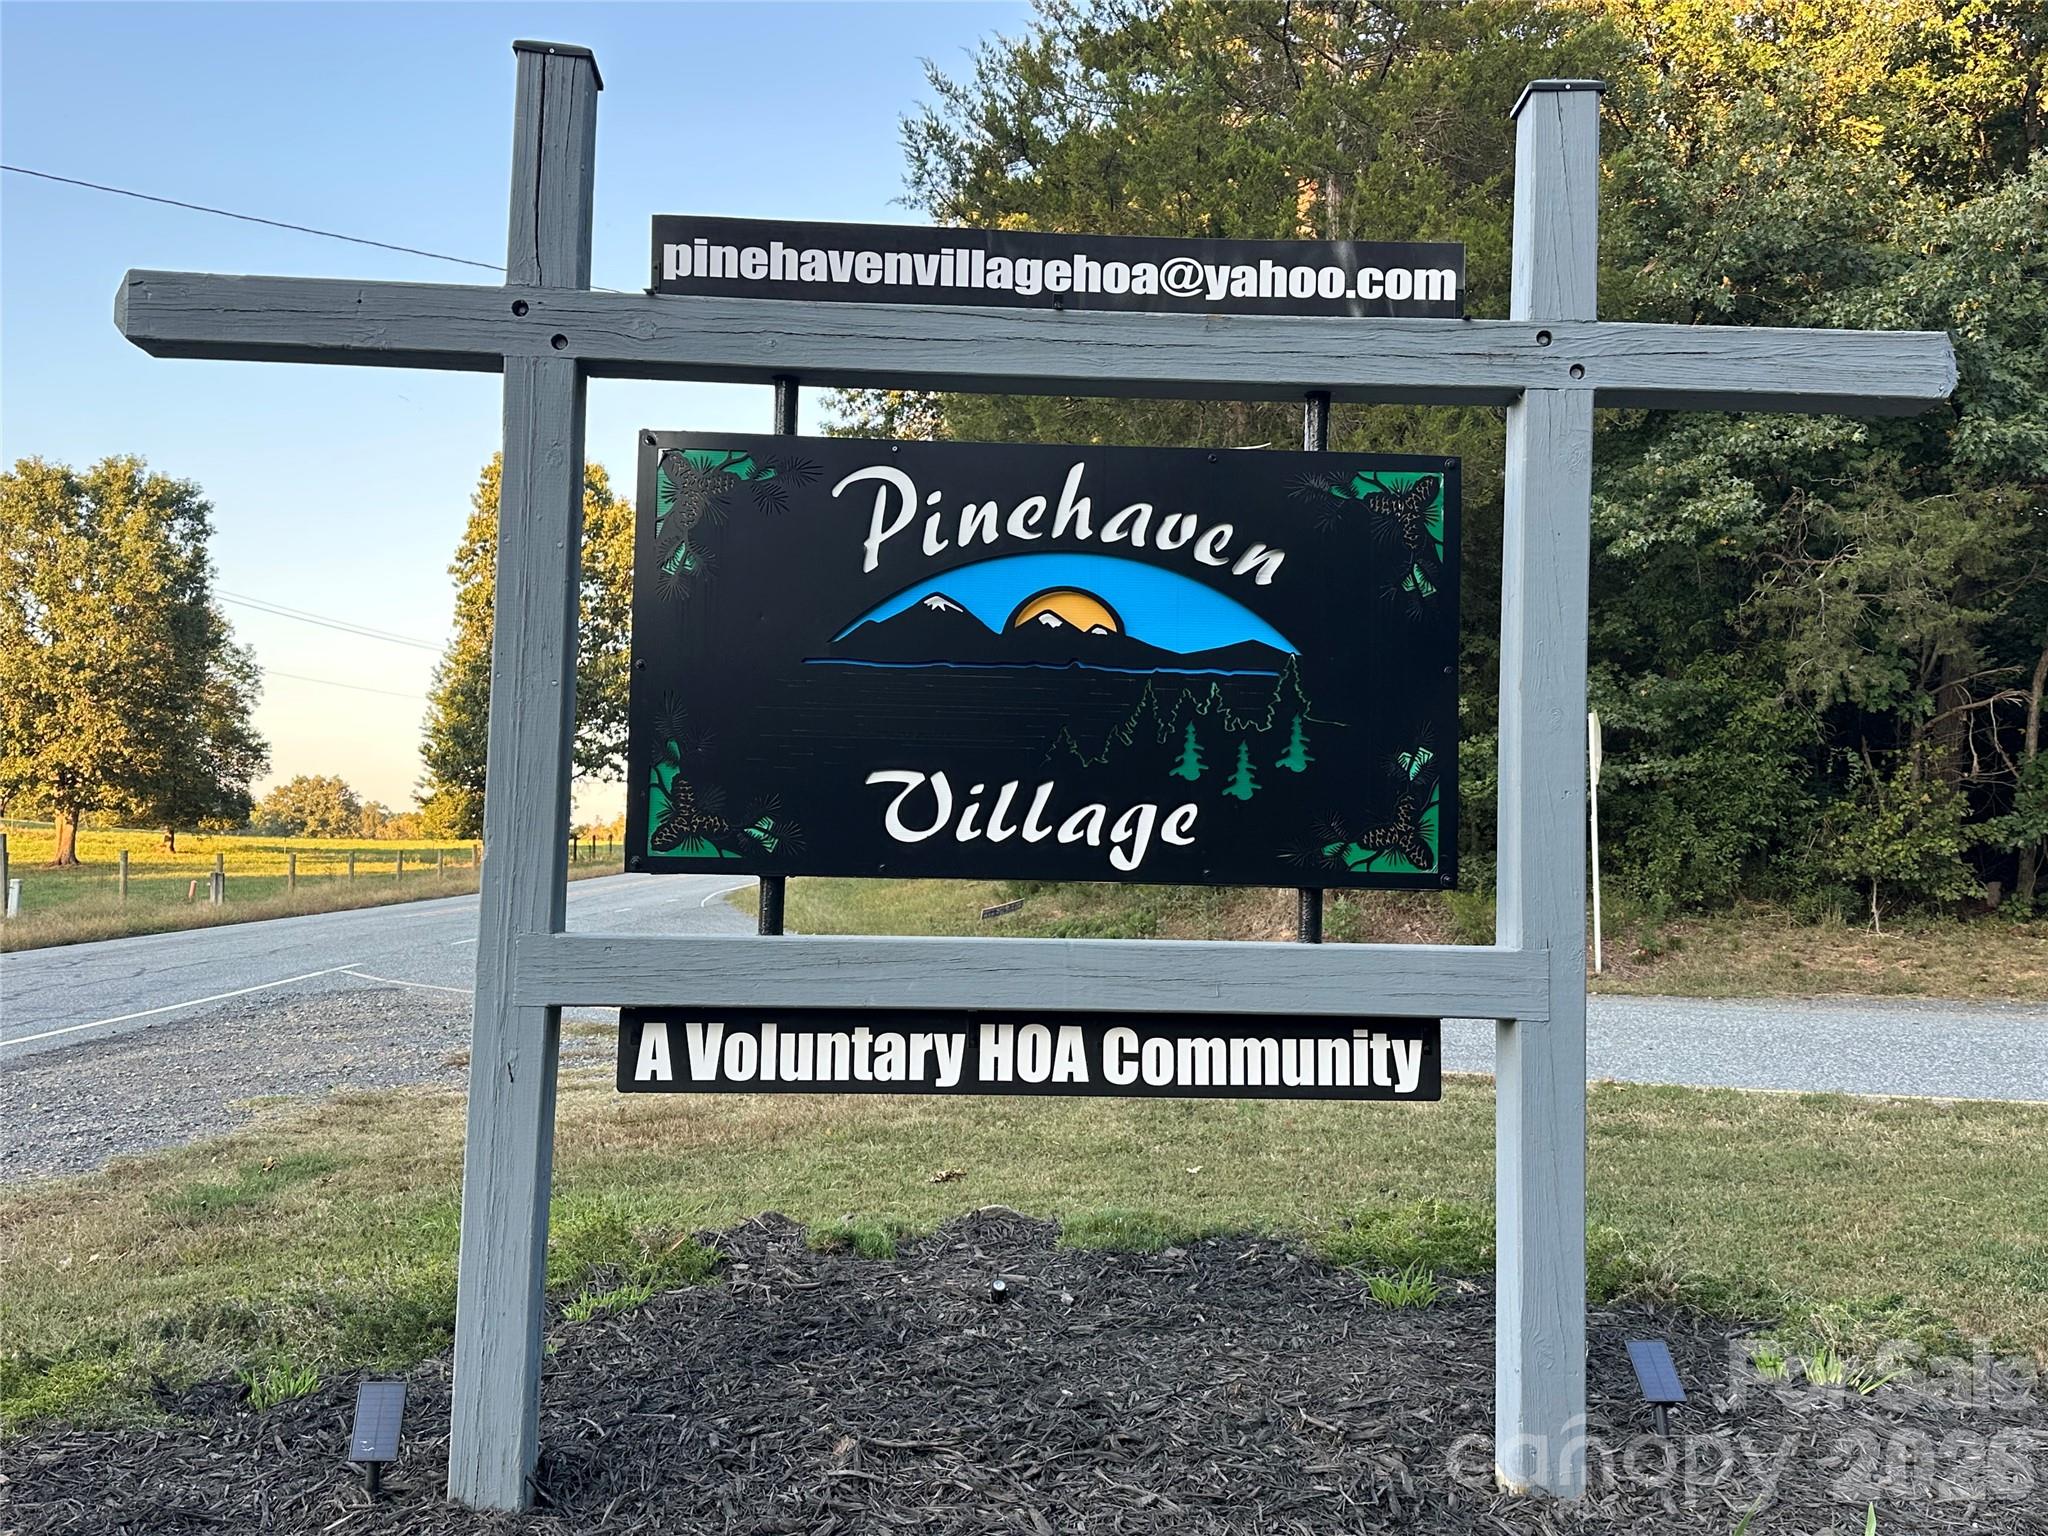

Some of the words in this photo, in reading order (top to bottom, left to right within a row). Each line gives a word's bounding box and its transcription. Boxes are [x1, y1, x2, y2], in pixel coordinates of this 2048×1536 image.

[662, 237, 1458, 302] pinehavenvillagehoa@yahoo.com
[831, 463, 1288, 587] Pinehaven
[866, 769, 1199, 873] Village
[634, 1022, 673, 1082] A
[685, 1022, 967, 1089] Voluntary
[978, 1023, 1090, 1083] HOA
[1102, 1027, 1424, 1094] Community
